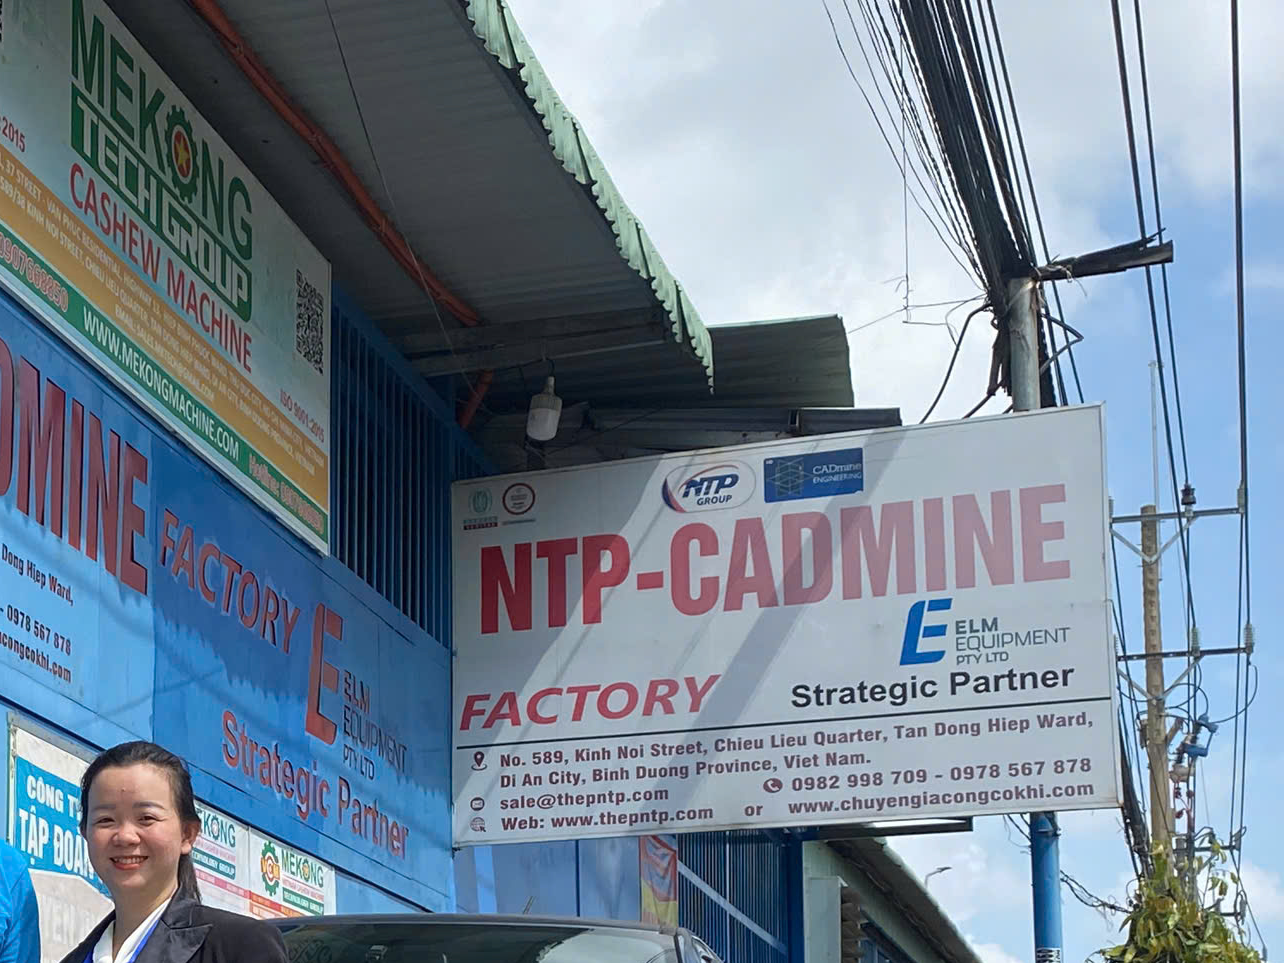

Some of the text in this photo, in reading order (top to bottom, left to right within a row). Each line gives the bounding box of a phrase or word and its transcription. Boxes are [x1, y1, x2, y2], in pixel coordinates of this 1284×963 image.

[72, 0, 252, 260] MEKONG
[15, 166, 41, 204] STREET
[70, 163, 160, 283] CASHEW
[167, 257, 251, 373] MACHINE
[83, 305, 240, 461] WWW.MEKONGMACHINE.COM
[682, 473, 739, 498] NTP
[697, 495, 732, 506] GROUP
[1, 542, 23, 576] Dong
[48, 572, 73, 607] Ward,
[480, 483, 1071, 634] NTP-CADMINE
[160, 508, 300, 654] FACTORY
[7, 602, 30, 633] 0978
[33, 619, 50, 645] 567
[53, 630, 70, 657] 878
[955, 617, 999, 635] ELM
[955, 627, 1071, 652] EQUIPMENT
[956, 651, 1009, 666] PTY LTD
[343, 669, 370, 714] ELM
[459, 674, 722, 731] FACTORY
[791, 667, 1075, 708] Strategic Partner
[343, 704, 407, 774] EQUIPMENT
[500, 711, 1092, 767] No. 589, Kinh Noi Street, Chieu Lieu Quarter, Tan Dong Hiep Ward,
[222, 710, 409, 861] Strategic Partner
[360, 755, 375, 780] LTD
[500, 750, 870, 787] Di An City, Binh Duong Province, Viet Nam.
[792, 774, 839, 791] 0982
[847, 772, 883, 788] 998
[890, 769, 927, 785] 709
[950, 763, 1000, 781] 0978
[1008, 761, 1045, 777] 567
[1053, 757, 1091, 774] 878
[27, 775, 64, 814] CÔNG
[499, 786, 668, 812] sale@thepntp.com
[788, 781, 1093, 816] www.chuyengiacongcokhi.com
[19, 806, 49, 866] TẬP
[501, 803, 762, 830] Web: www.thepntp.com or
[281, 848, 324, 888] MEKONG
